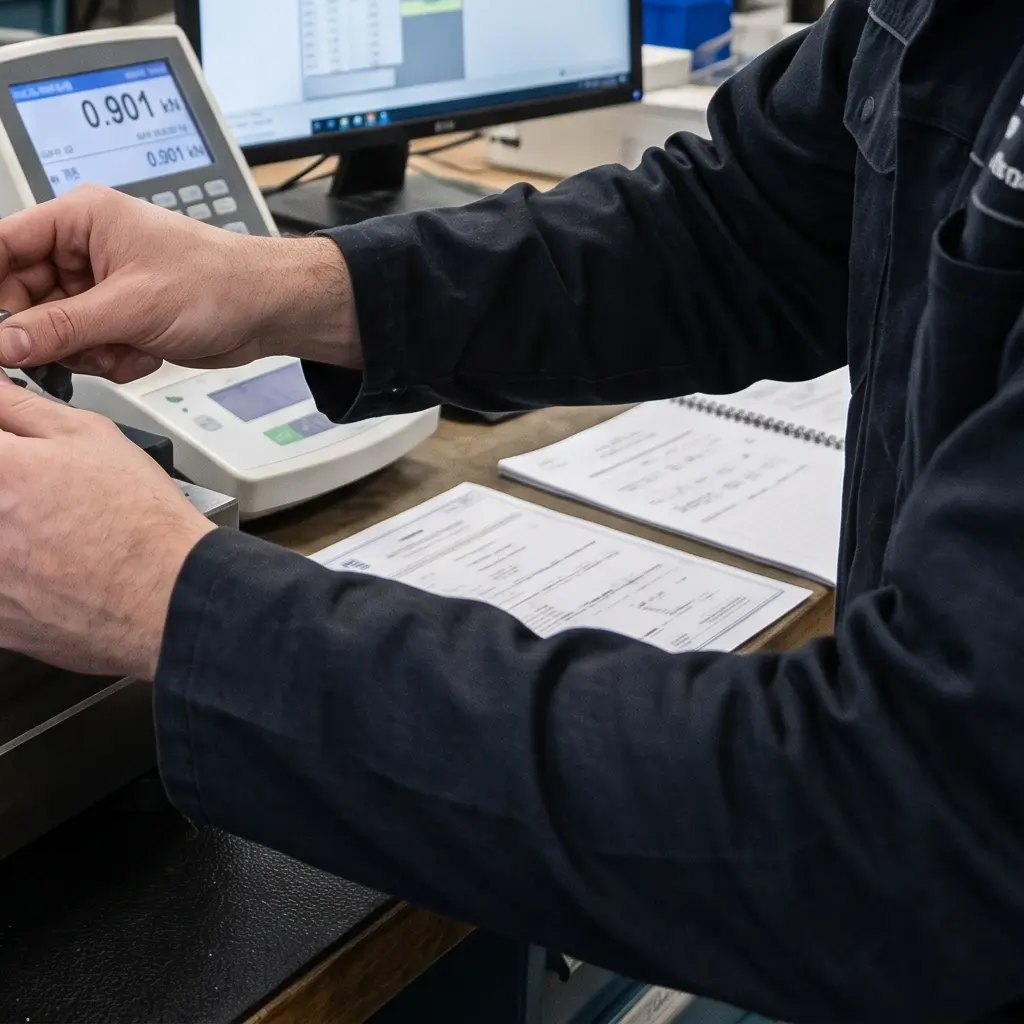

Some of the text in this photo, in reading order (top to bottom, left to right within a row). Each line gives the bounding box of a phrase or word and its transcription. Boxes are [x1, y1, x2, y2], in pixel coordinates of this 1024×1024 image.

[81, 90, 155, 128] 0.901
[160, 98, 181, 113] kN
[146, 146, 185, 167] 0.901
